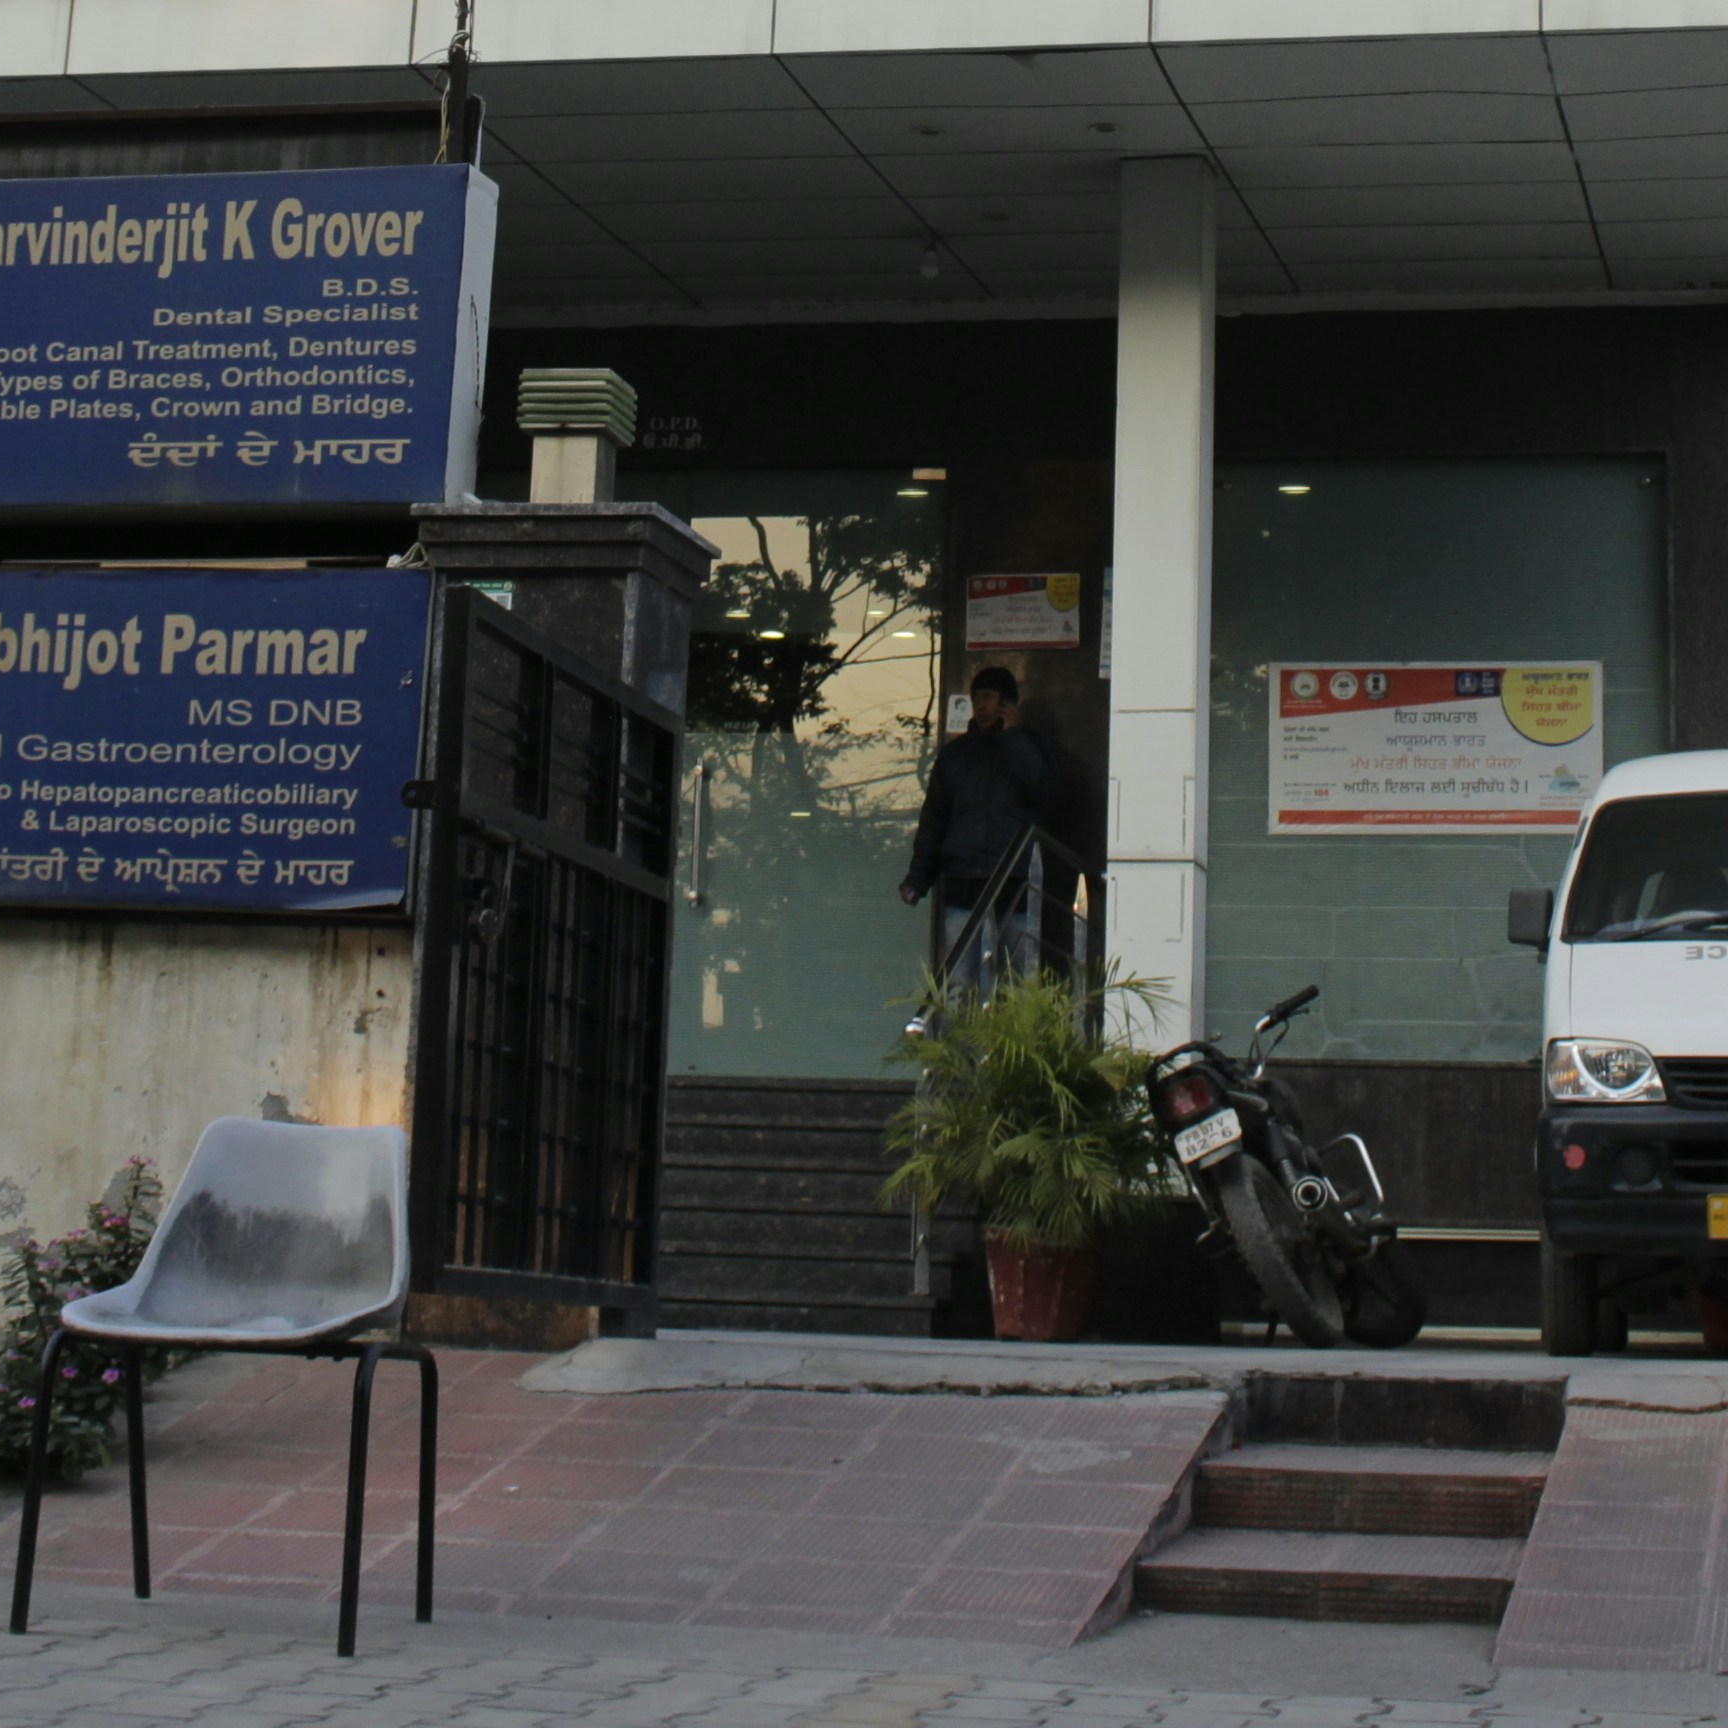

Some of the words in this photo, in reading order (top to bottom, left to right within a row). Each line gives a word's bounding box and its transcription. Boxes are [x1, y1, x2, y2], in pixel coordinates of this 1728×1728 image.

[222, 198, 258, 261] K
[271, 197, 424, 260] Grover
[322, 277, 420, 298] B.D.S.
[153, 305, 252, 327] Dental
[262, 302, 420, 328] Specialist
[45, 340, 124, 363] Canal
[132, 338, 279, 363] Treatment,
[288, 336, 418, 359] Dentures
[72, 369, 101, 390] of
[107, 367, 212, 392] Braces,
[220, 364, 416, 389] Orthodontics,
[49, 399, 142, 422] Plates,
[150, 397, 241, 419] Crown
[249, 395, 304, 416] and
[311, 394, 415, 420] Bridge.
[235, 431, 278, 466] ਦੇ
[292, 438, 411, 466] ਮਾਹਰ
[160, 613, 367, 675] Parmar
[188, 699, 253, 726] MS
[269, 699, 363, 726] DNB
[17, 734, 362, 770] Gastroenterology
[19, 779, 359, 810] Hepatopancreaticobiliary
[20, 809, 40, 832] &
[47, 809, 232, 839] Laparoscopic
[239, 814, 356, 841] Surgeon
